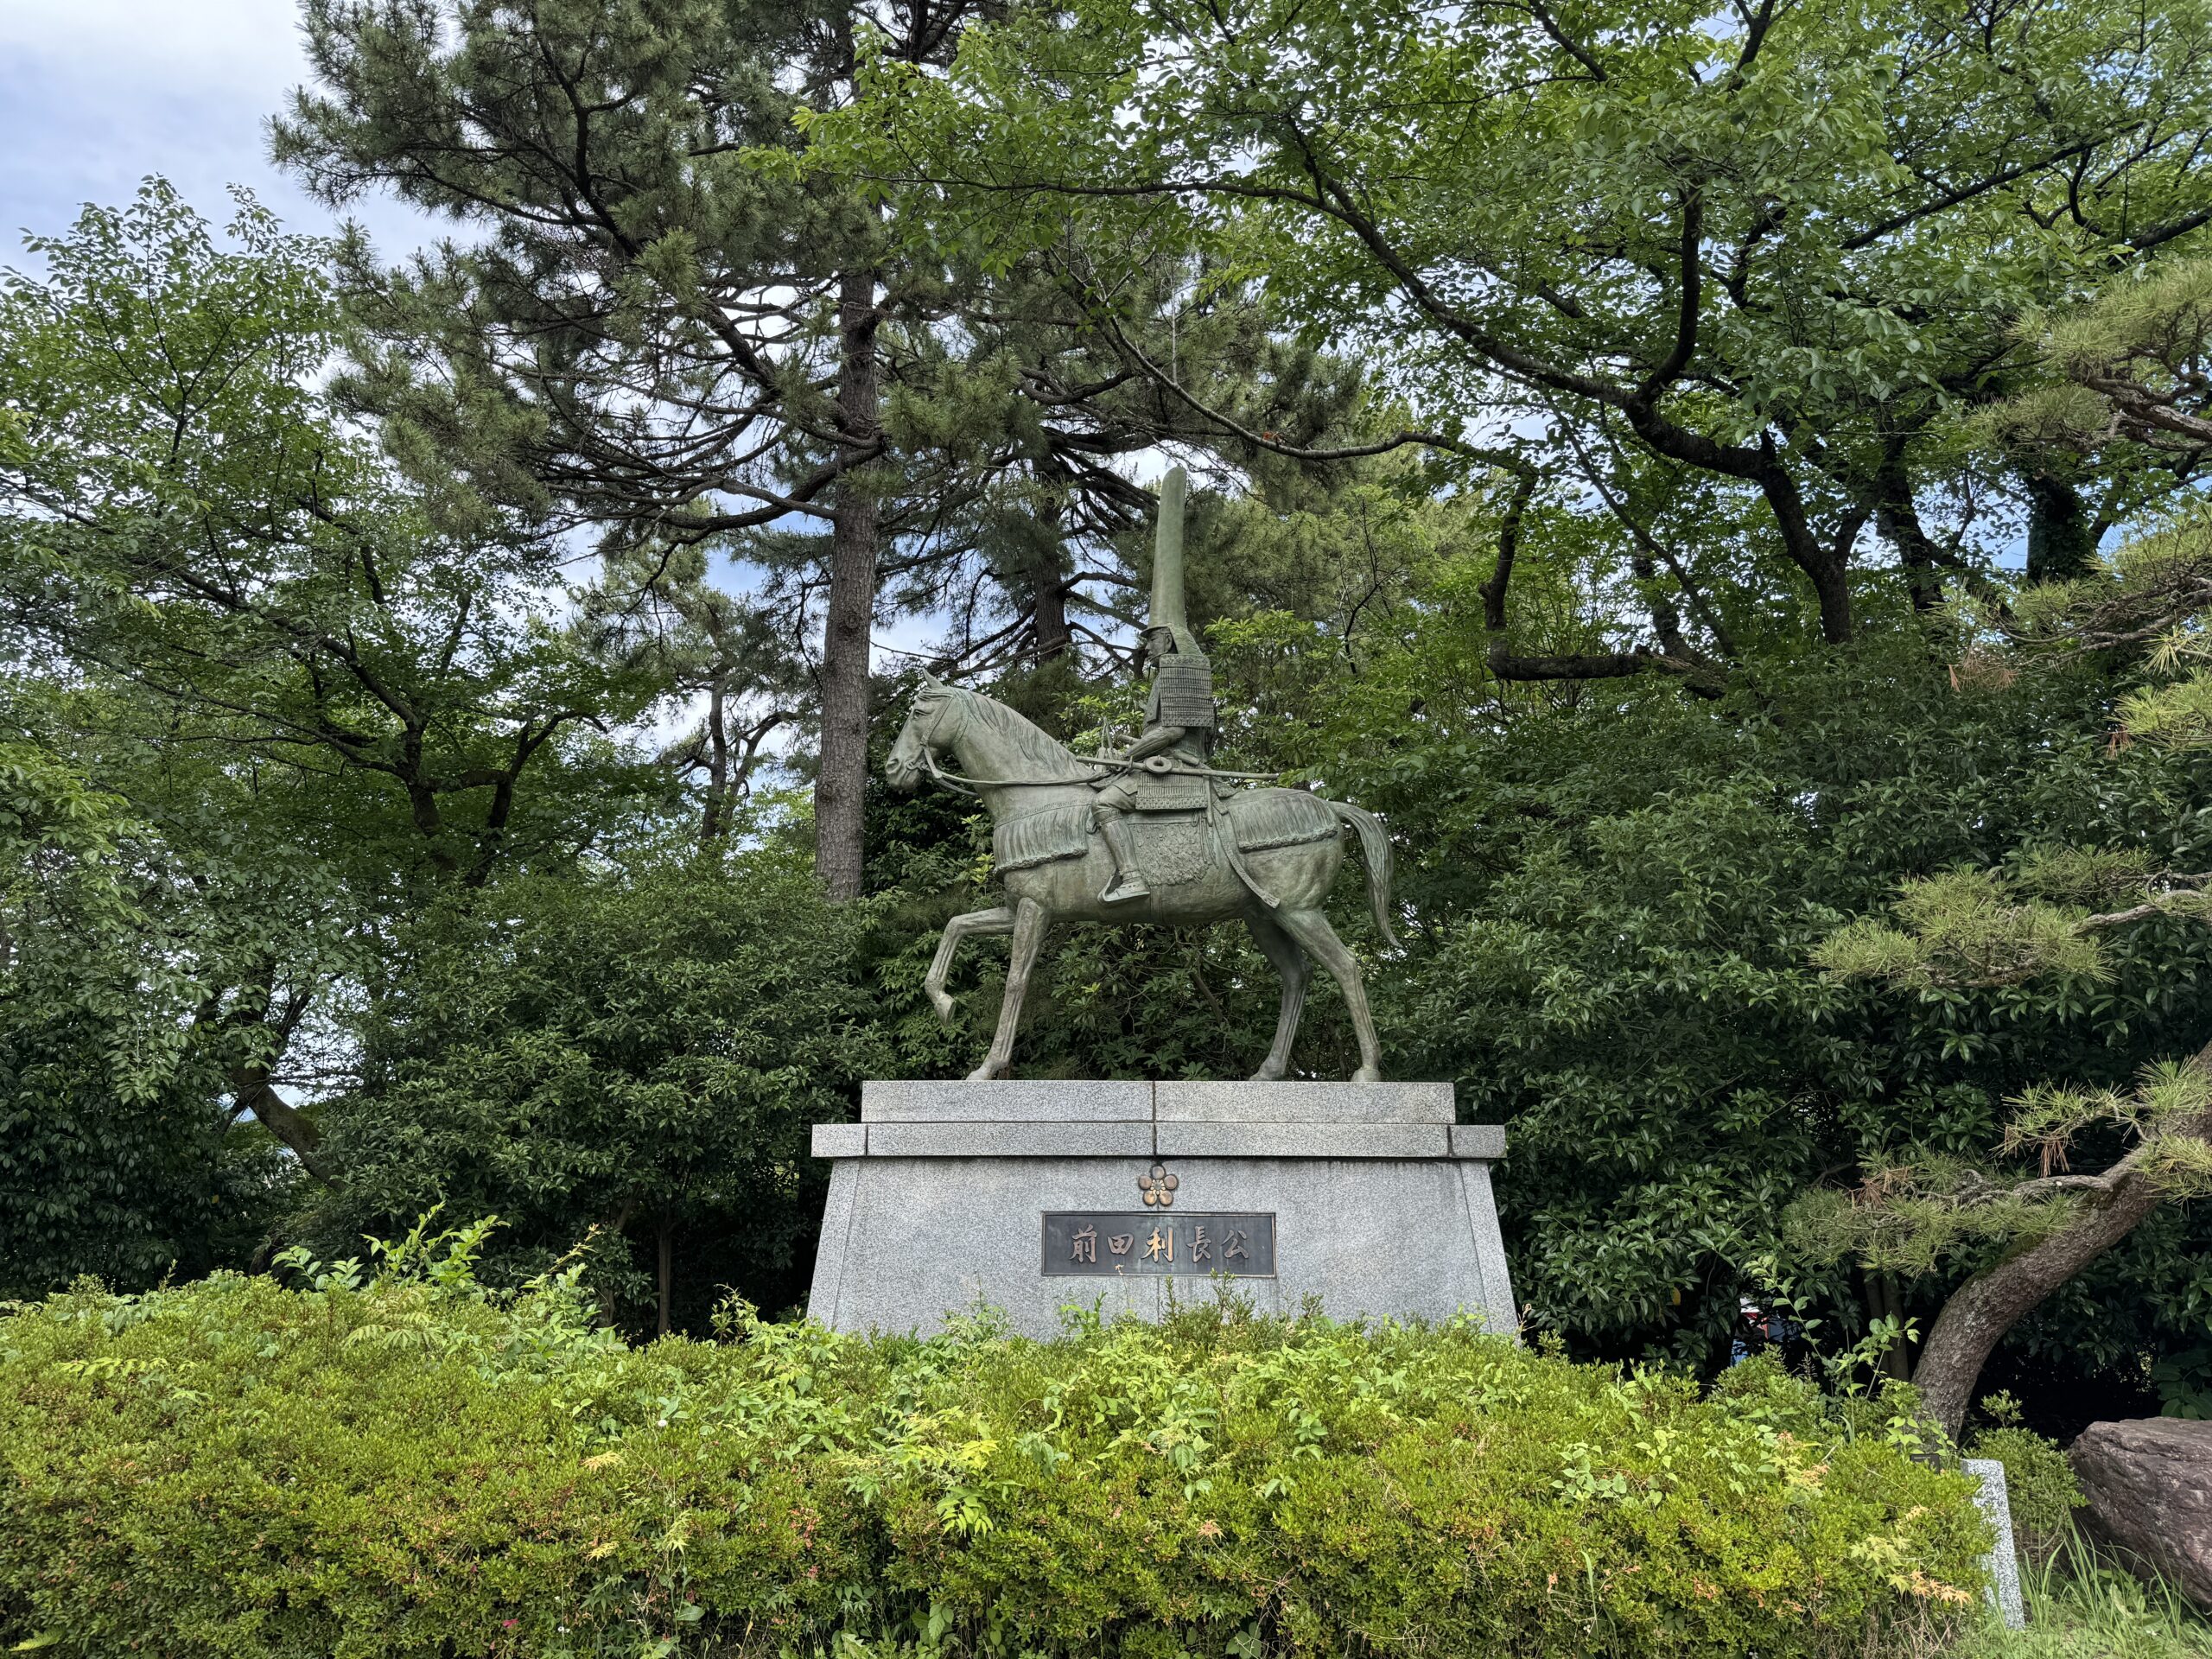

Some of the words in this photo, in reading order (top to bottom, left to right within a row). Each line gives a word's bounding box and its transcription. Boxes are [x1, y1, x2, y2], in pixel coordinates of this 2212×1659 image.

[1070, 1224, 1249, 1263] 前田利長公
